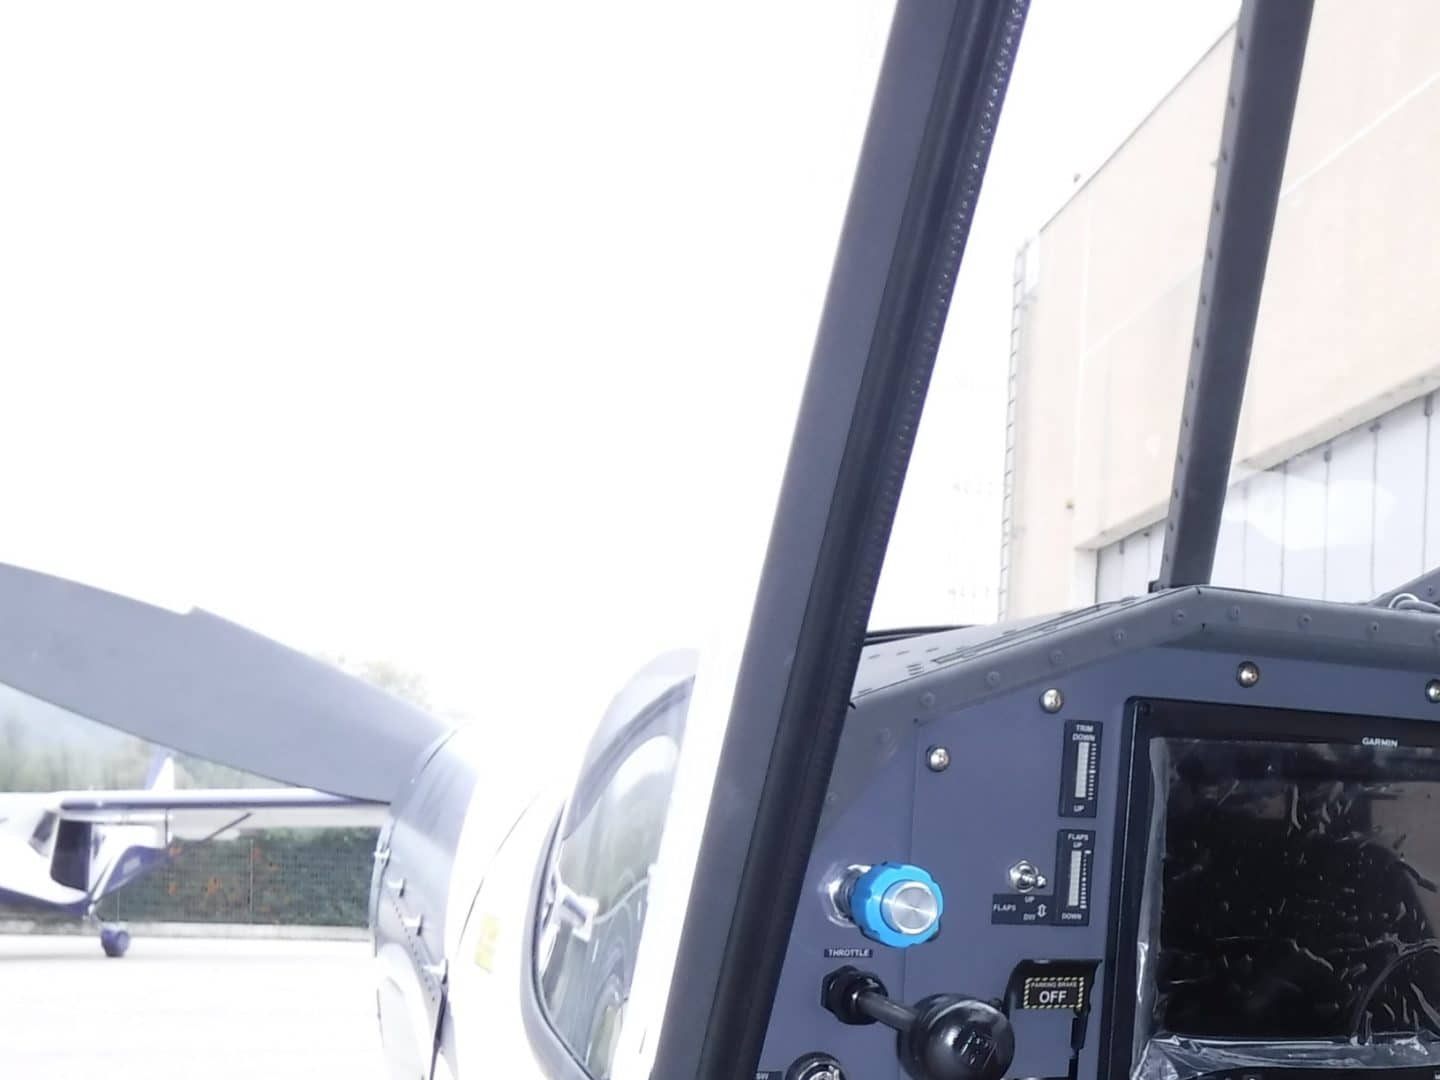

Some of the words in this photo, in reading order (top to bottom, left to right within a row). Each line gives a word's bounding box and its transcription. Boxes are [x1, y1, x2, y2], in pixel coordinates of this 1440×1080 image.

[1076, 724, 1094, 732] TRIM
[1072, 733, 1096, 741] DOWN
[1361, 737, 1399, 749] GARMIN
[1073, 805, 1085, 813] UP
[1068, 833, 1089, 841] FLAPS
[993, 904, 1017, 912] FLAPS
[1061, 912, 1083, 920] DOWN
[827, 949, 870, 957] THROTTLE
[1031, 981, 1057, 989] PARKING
[1038, 991, 1067, 1004] OFF
